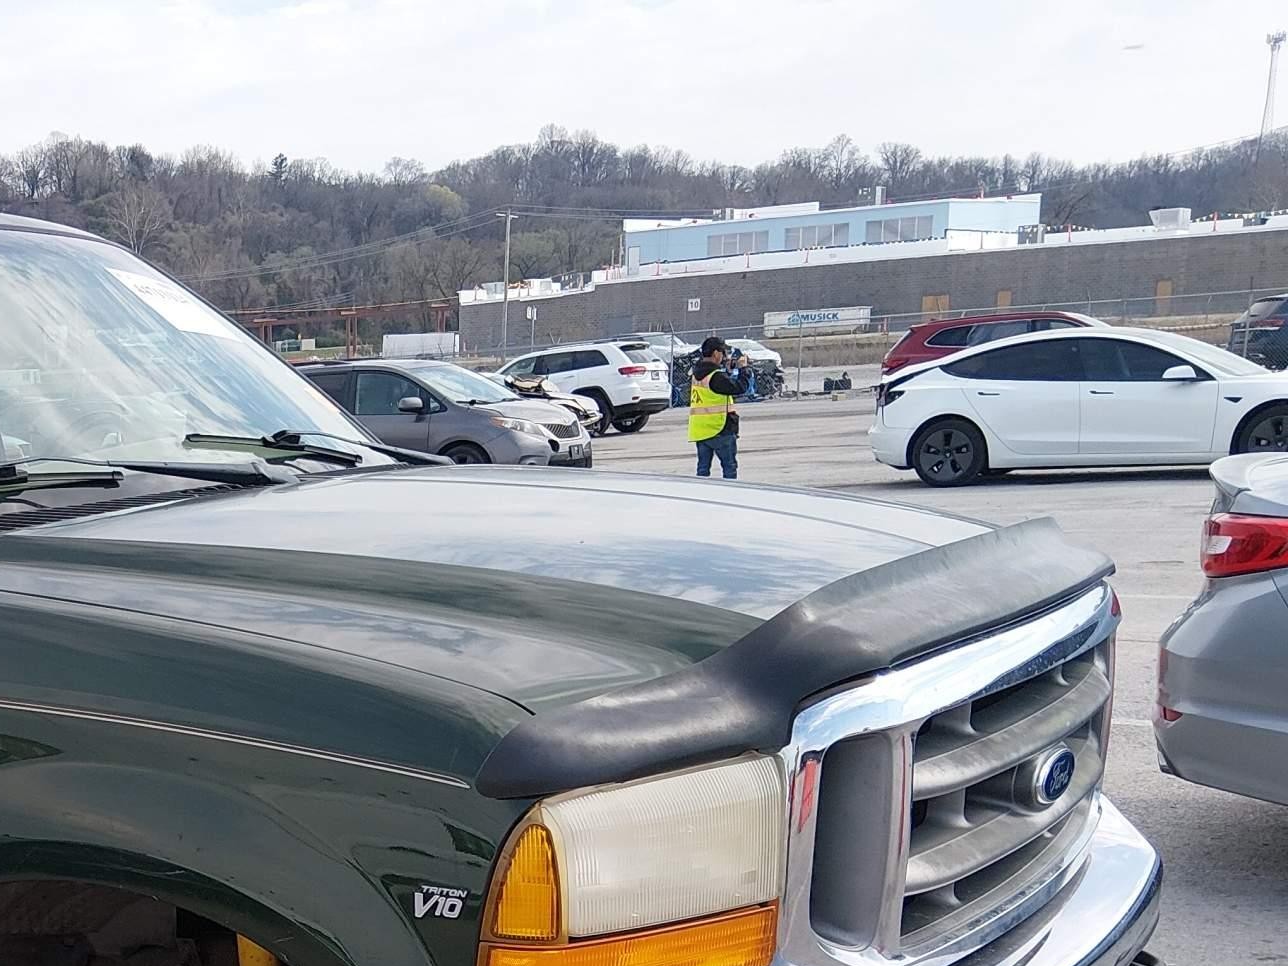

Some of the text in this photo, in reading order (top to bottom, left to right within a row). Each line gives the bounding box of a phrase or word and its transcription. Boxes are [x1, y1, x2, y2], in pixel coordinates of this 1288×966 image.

[689, 301, 698, 309] 10
[800, 312, 839, 322] MUSICK
[1049, 758, 1072, 794] Ford
[421, 884, 468, 899] TRITON
[414, 891, 463, 919] V10
